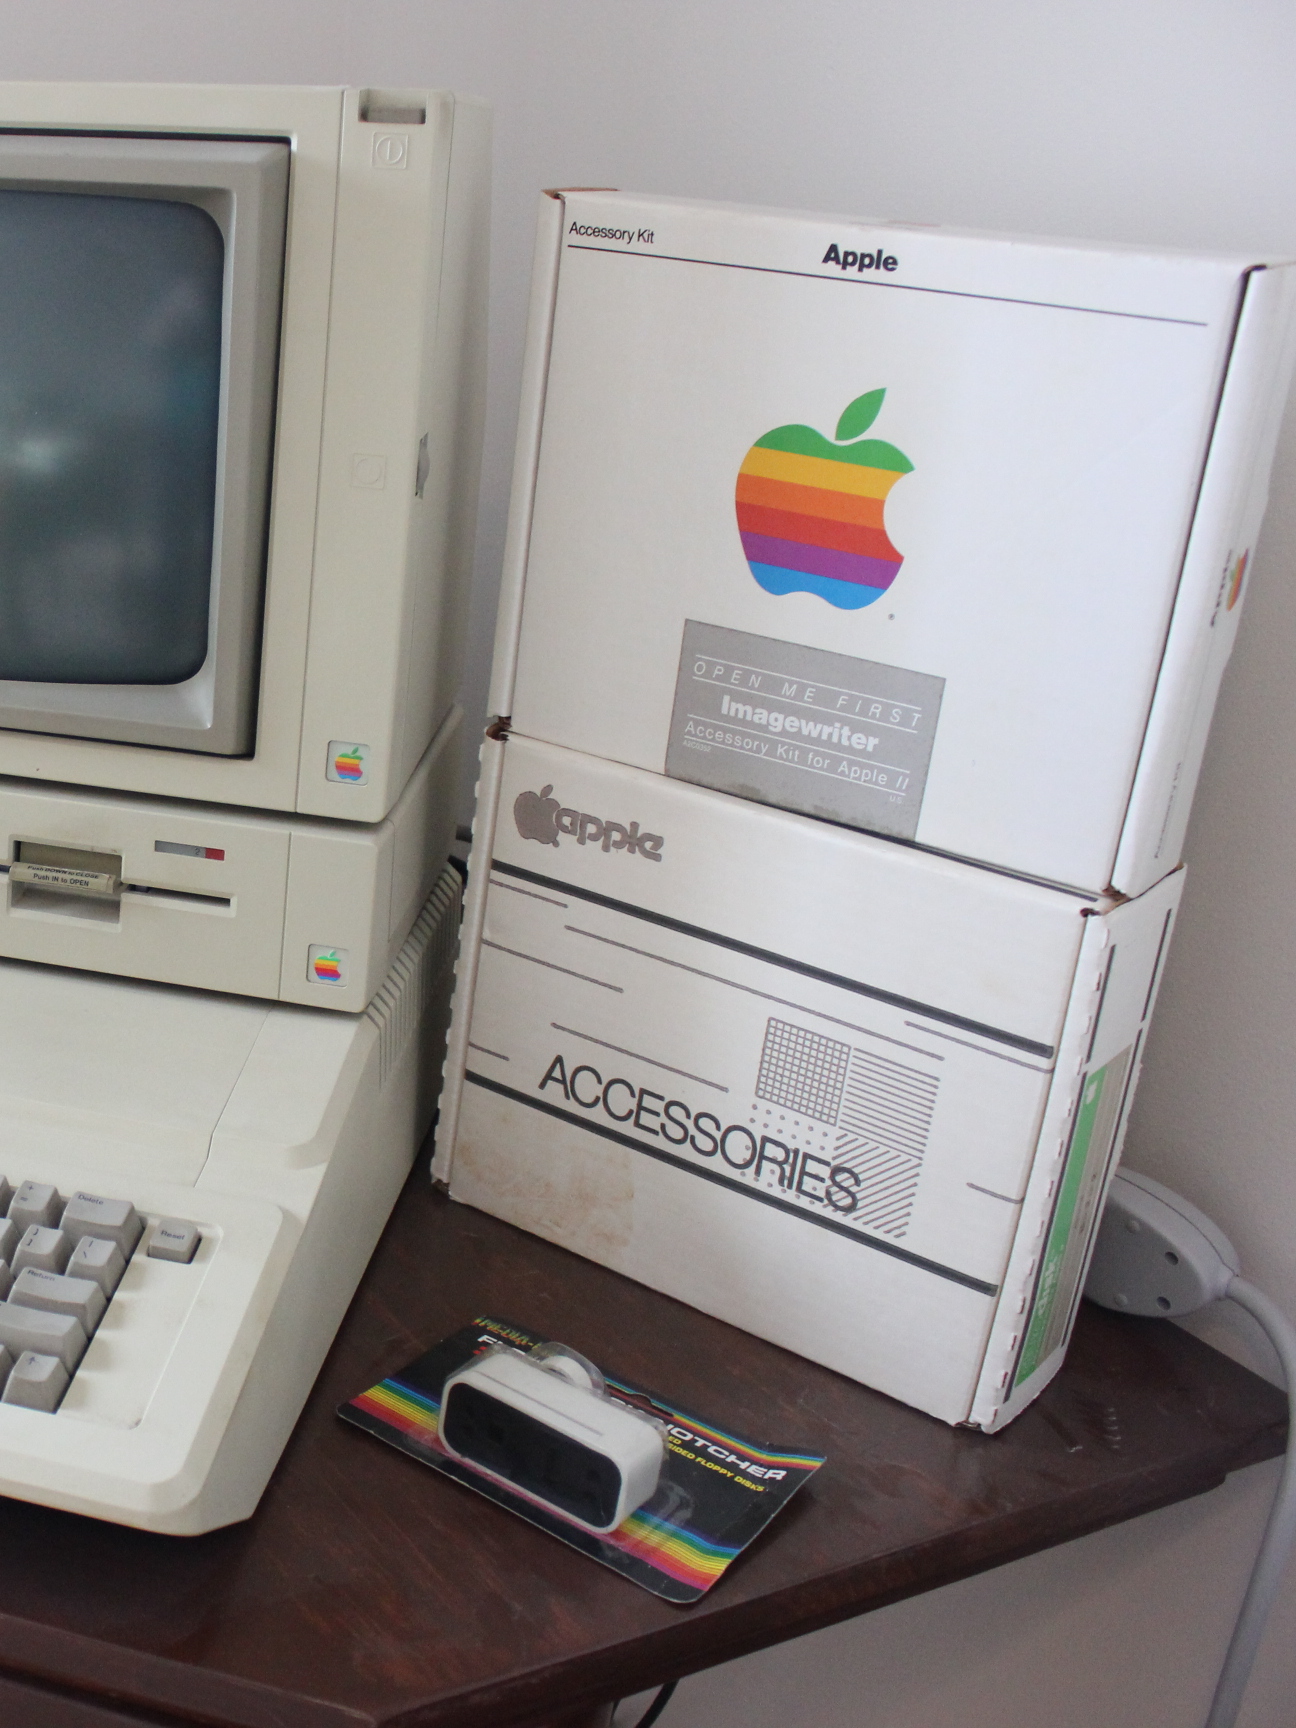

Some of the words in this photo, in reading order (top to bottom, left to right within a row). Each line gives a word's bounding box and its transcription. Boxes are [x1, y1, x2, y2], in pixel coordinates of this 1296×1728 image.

[569, 221, 635, 244] Accessory
[637, 228, 655, 244] Kit
[822, 243, 898, 273] Apple
[694, 661, 762, 688] OPEN
[781, 682, 816, 702] ME
[837, 695, 922, 728] FIRST
[721, 694, 880, 752] Imagewriter
[685, 720, 769, 756] Accessory
[777, 743, 800, 762] Kit
[807, 752, 830, 769] for
[838, 761, 887, 785] Apple
[555, 808, 664, 862] apple
[33, 873, 49, 881] Push
[69, 878, 90, 887] OPEN
[538, 1054, 861, 1214] ACCESSORIES
[78, 1194, 104, 1206] Delete
[160, 1230, 186, 1240] Reset
[27, 1269, 56, 1282] Return
[666, 1424, 788, 1480] OTCHER
[695, 1457, 734, 1478] FLOPPY
[734, 1475, 765, 1492] DISKS
